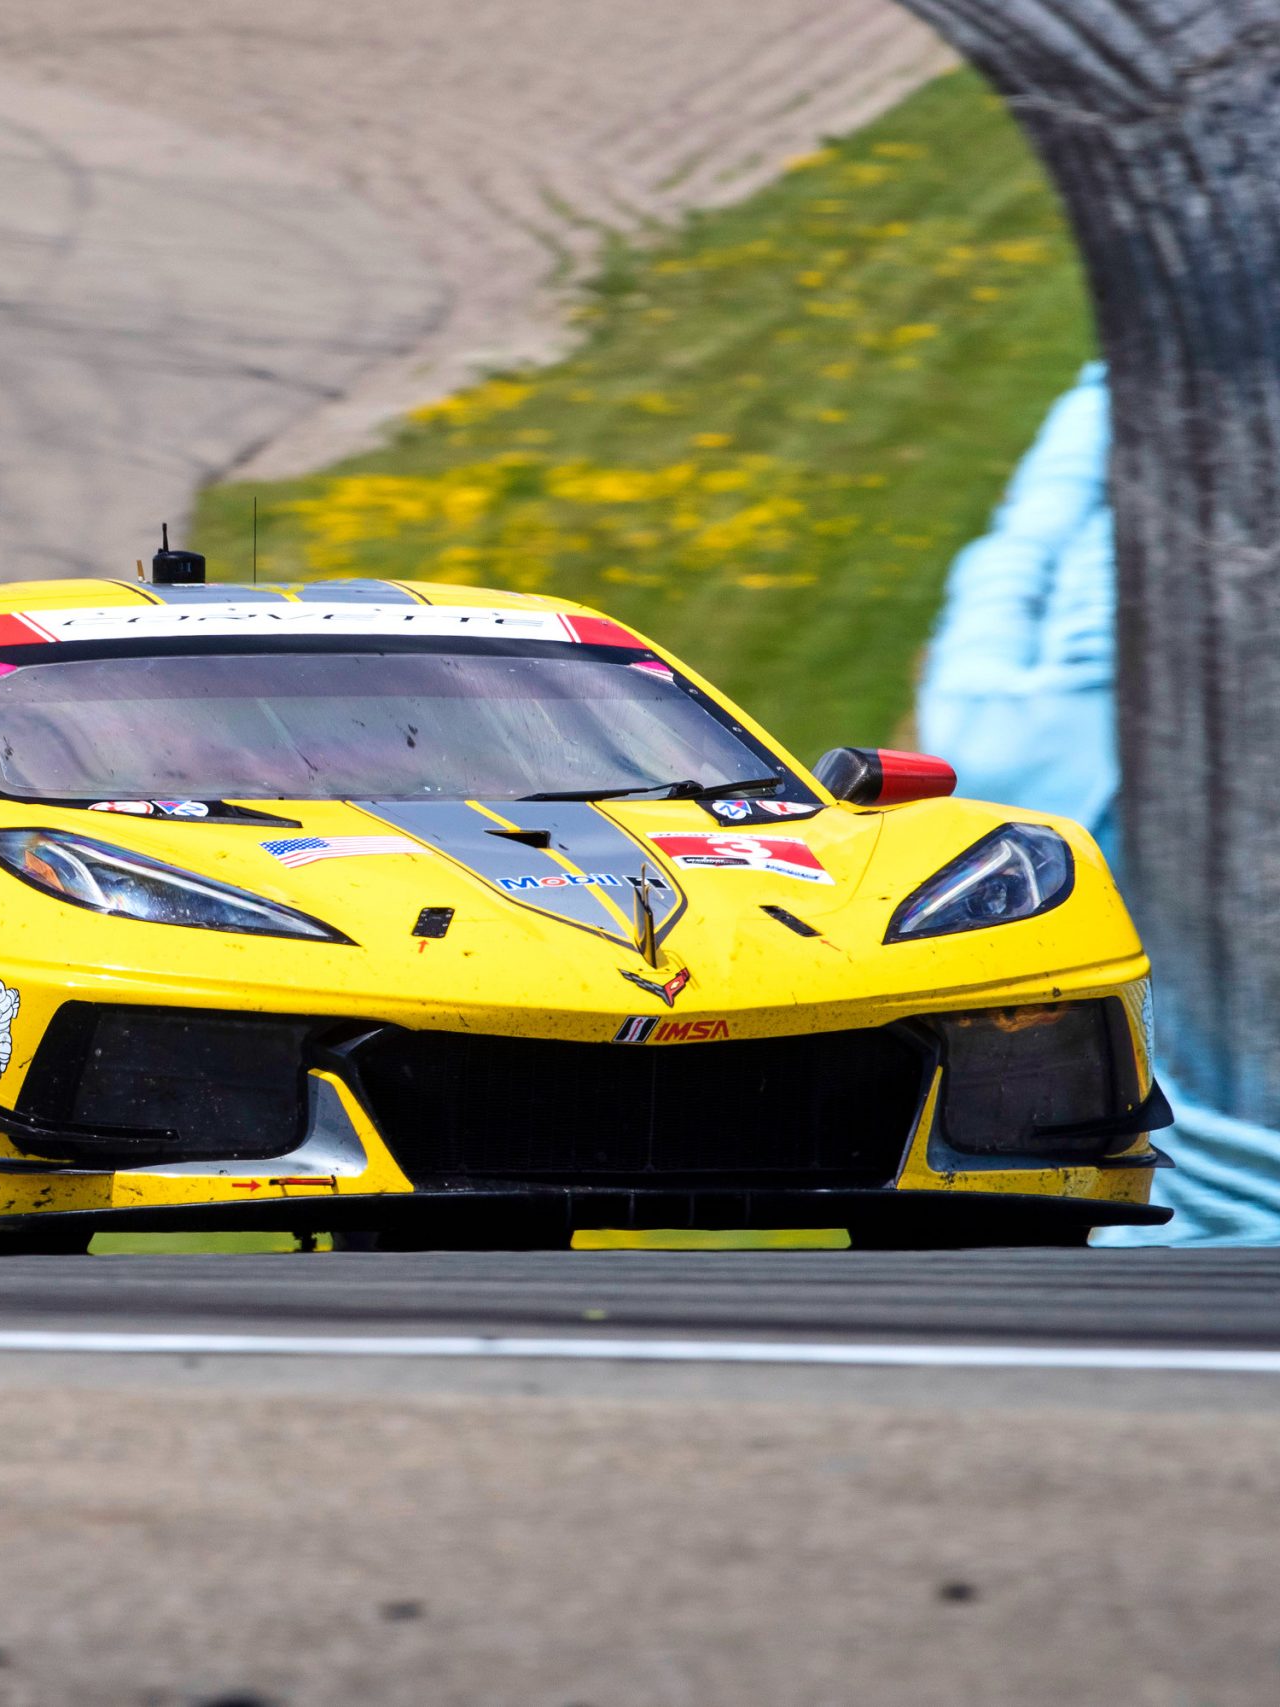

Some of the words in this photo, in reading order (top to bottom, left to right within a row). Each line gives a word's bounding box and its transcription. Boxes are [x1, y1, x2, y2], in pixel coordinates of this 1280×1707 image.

[706, 837, 773, 859] 3
[497, 874, 623, 891] Mobil
[654, 1019, 730, 1042] IMSA
